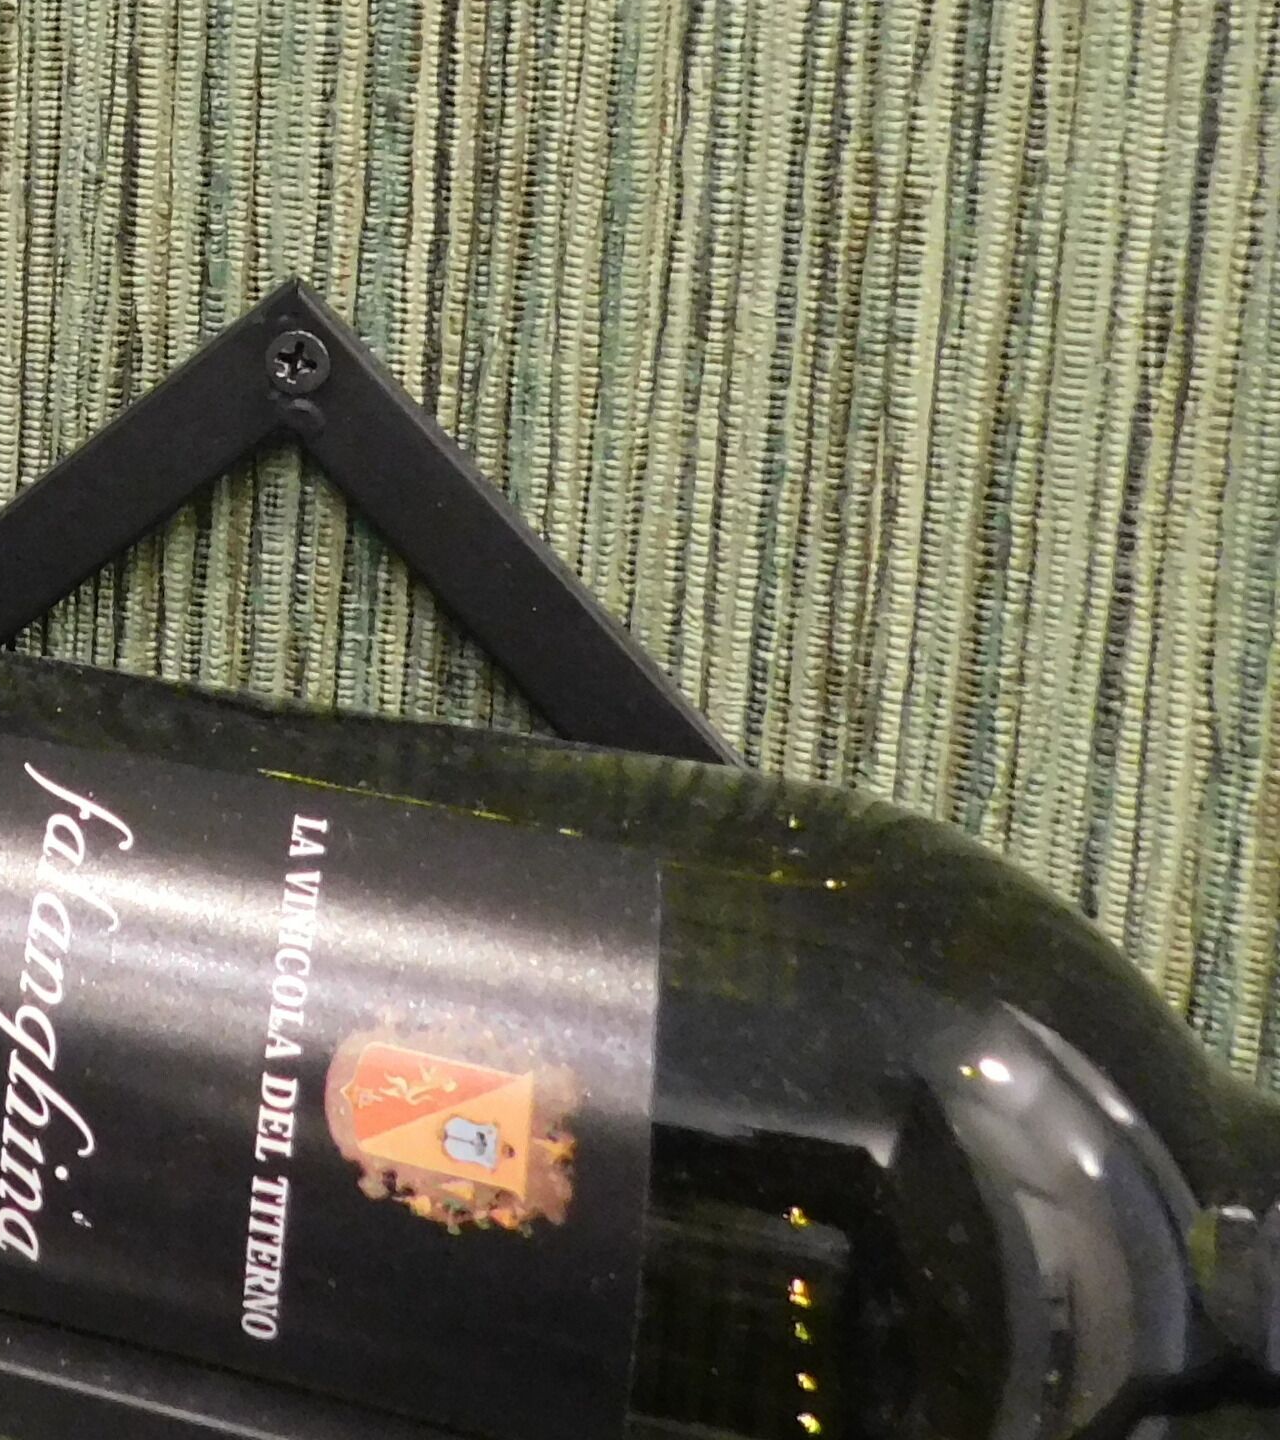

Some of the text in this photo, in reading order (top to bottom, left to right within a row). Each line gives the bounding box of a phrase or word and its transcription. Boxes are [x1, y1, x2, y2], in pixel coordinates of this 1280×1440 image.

[240, 814, 329, 1341] LA VINICOLA DEL TITERNO
